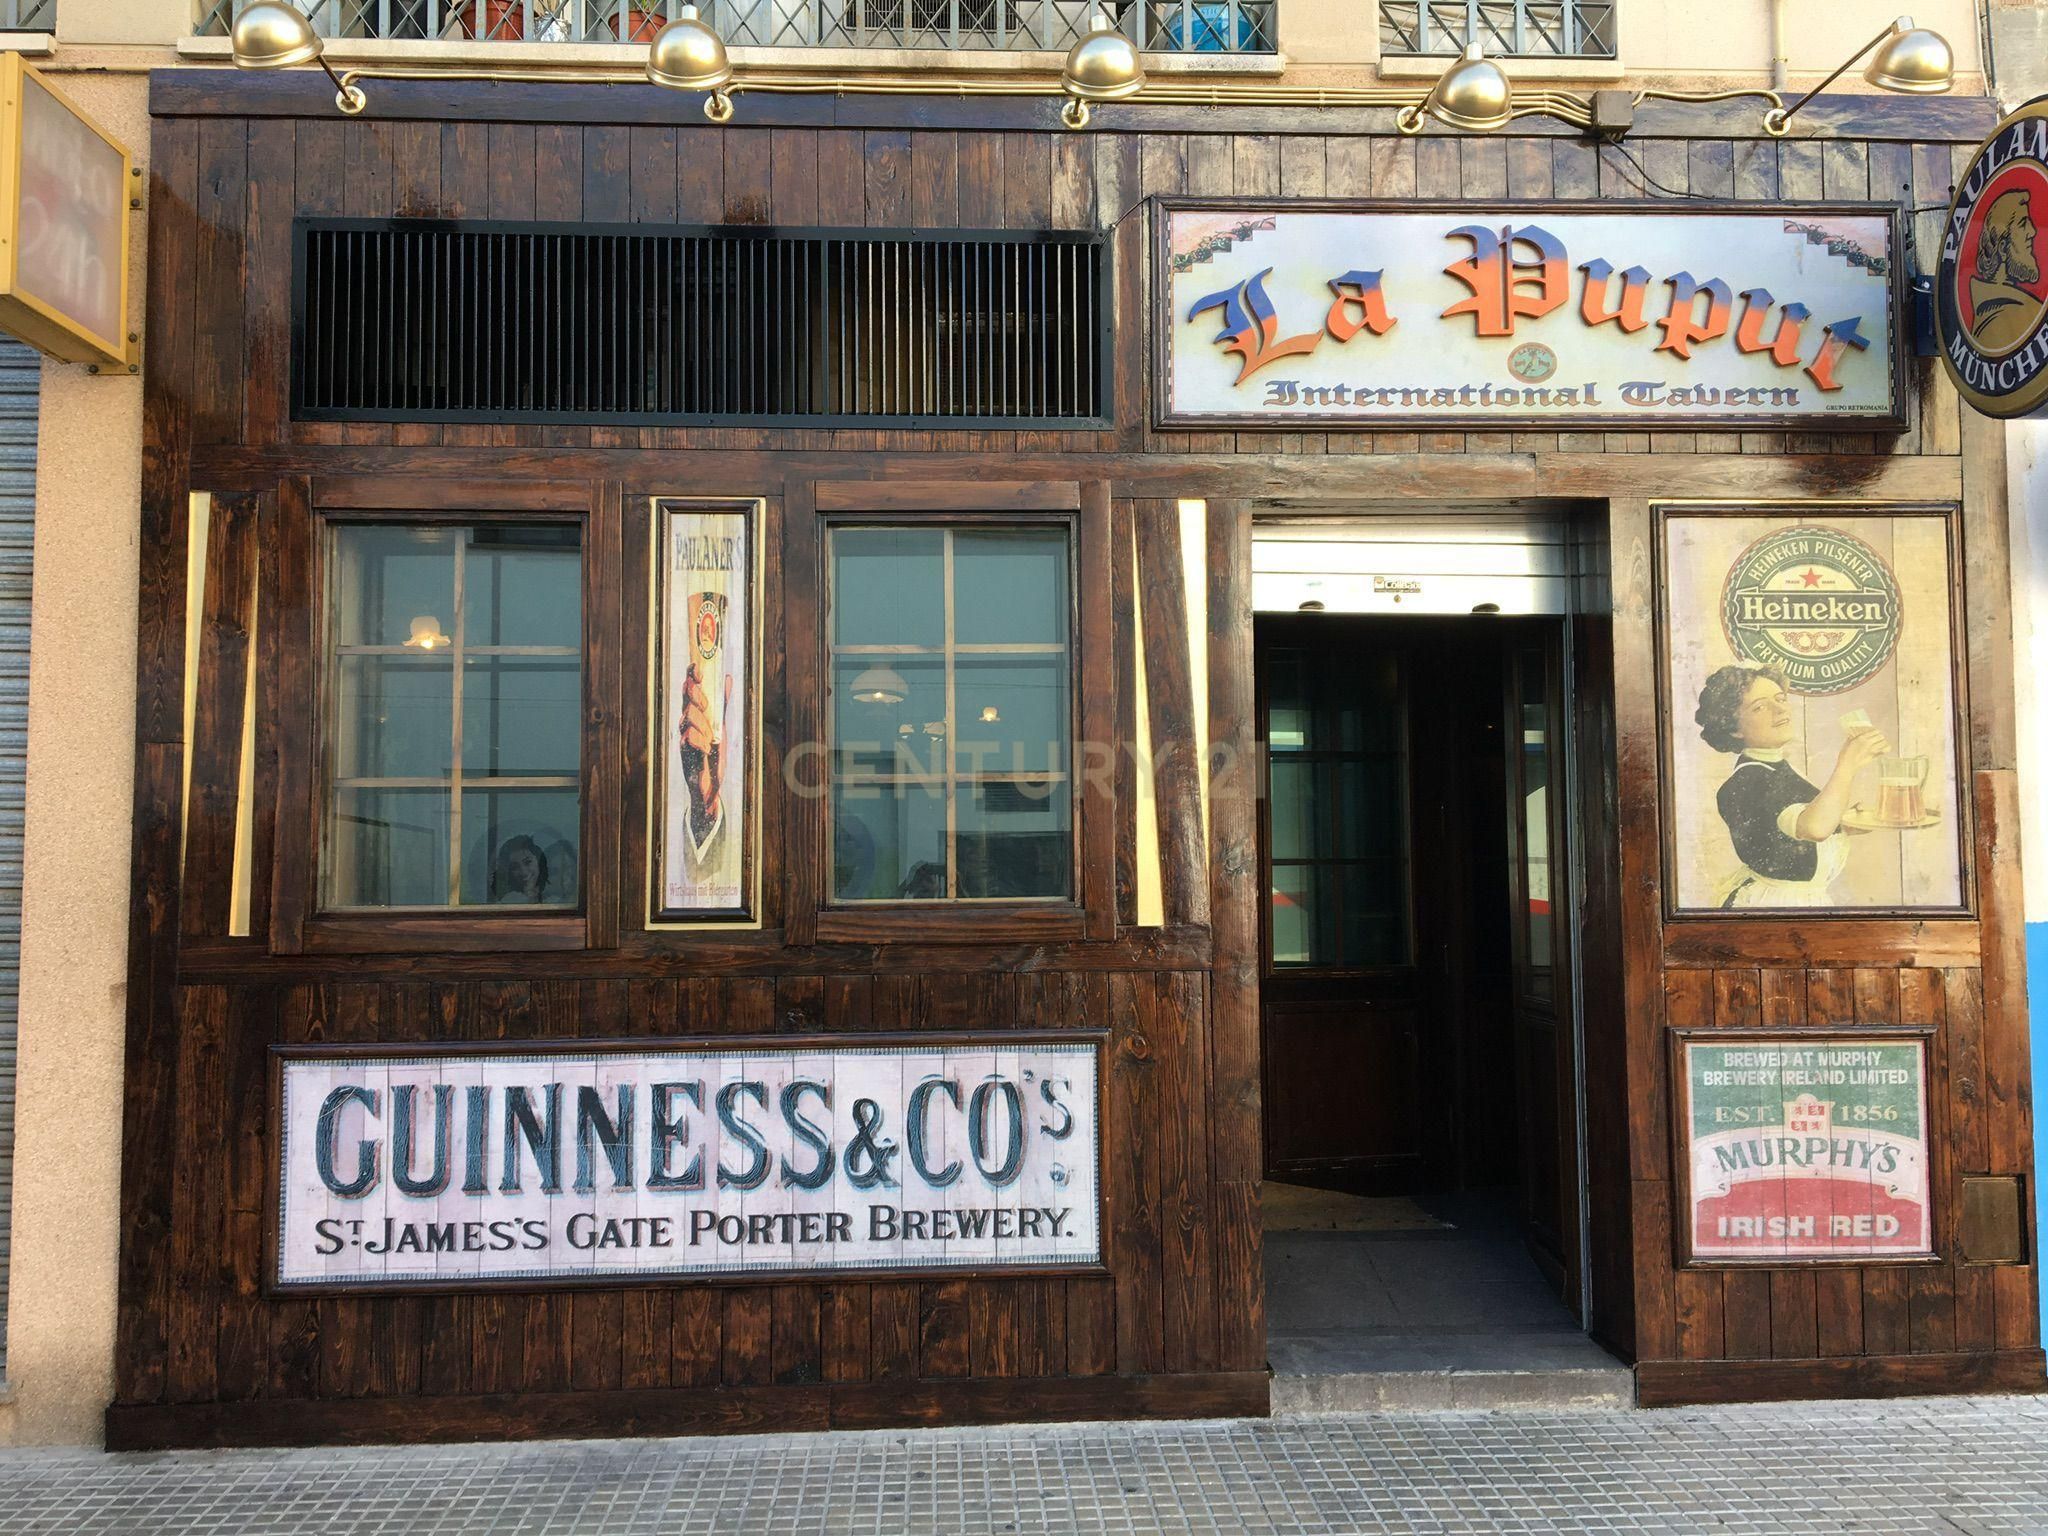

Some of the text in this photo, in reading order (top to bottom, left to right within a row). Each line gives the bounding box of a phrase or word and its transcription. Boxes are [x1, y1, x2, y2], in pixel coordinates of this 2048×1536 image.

[1189, 224, 1871, 393] La Puput
[1263, 380, 1801, 408] International Tavern
[1748, 541, 1873, 582] HEINEKEN PILSENER
[1742, 596, 1883, 621] Heineken
[1753, 640, 1873, 679] PREMIUM QUALITY
[1724, 1051, 1882, 1067] BREWED AT MURPHY
[1704, 1069, 1908, 1086] BREWERY IRELAND LIMITED
[1715, 1104, 1899, 1122] EST. 1856
[315, 1076, 836, 1198] GUINNESS
[1712, 1137, 1901, 1173] MURPHY'S
[566, 1213, 672, 1250] GATE
[689, 1208, 853, 1248] PORTER
[868, 1203, 1075, 1243] BREWERY.
[1718, 1215, 1900, 1238] IRISH RED
